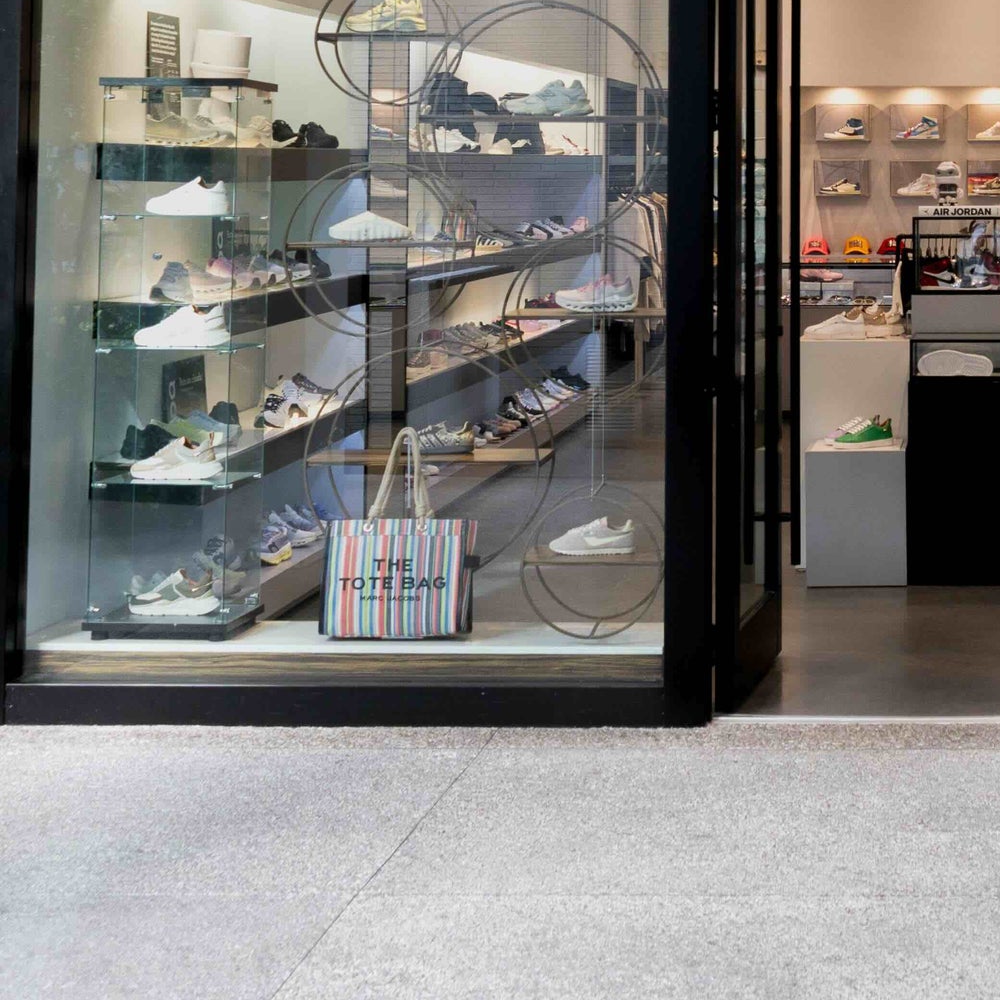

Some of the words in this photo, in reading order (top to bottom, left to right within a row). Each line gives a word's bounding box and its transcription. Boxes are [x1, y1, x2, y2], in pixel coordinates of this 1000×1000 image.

[933, 208, 949, 216] AIR
[951, 208, 992, 216] JORDAN
[373, 558, 413, 572] THE
[339, 576, 393, 591] TOTE
[401, 576, 446, 590] BAG
